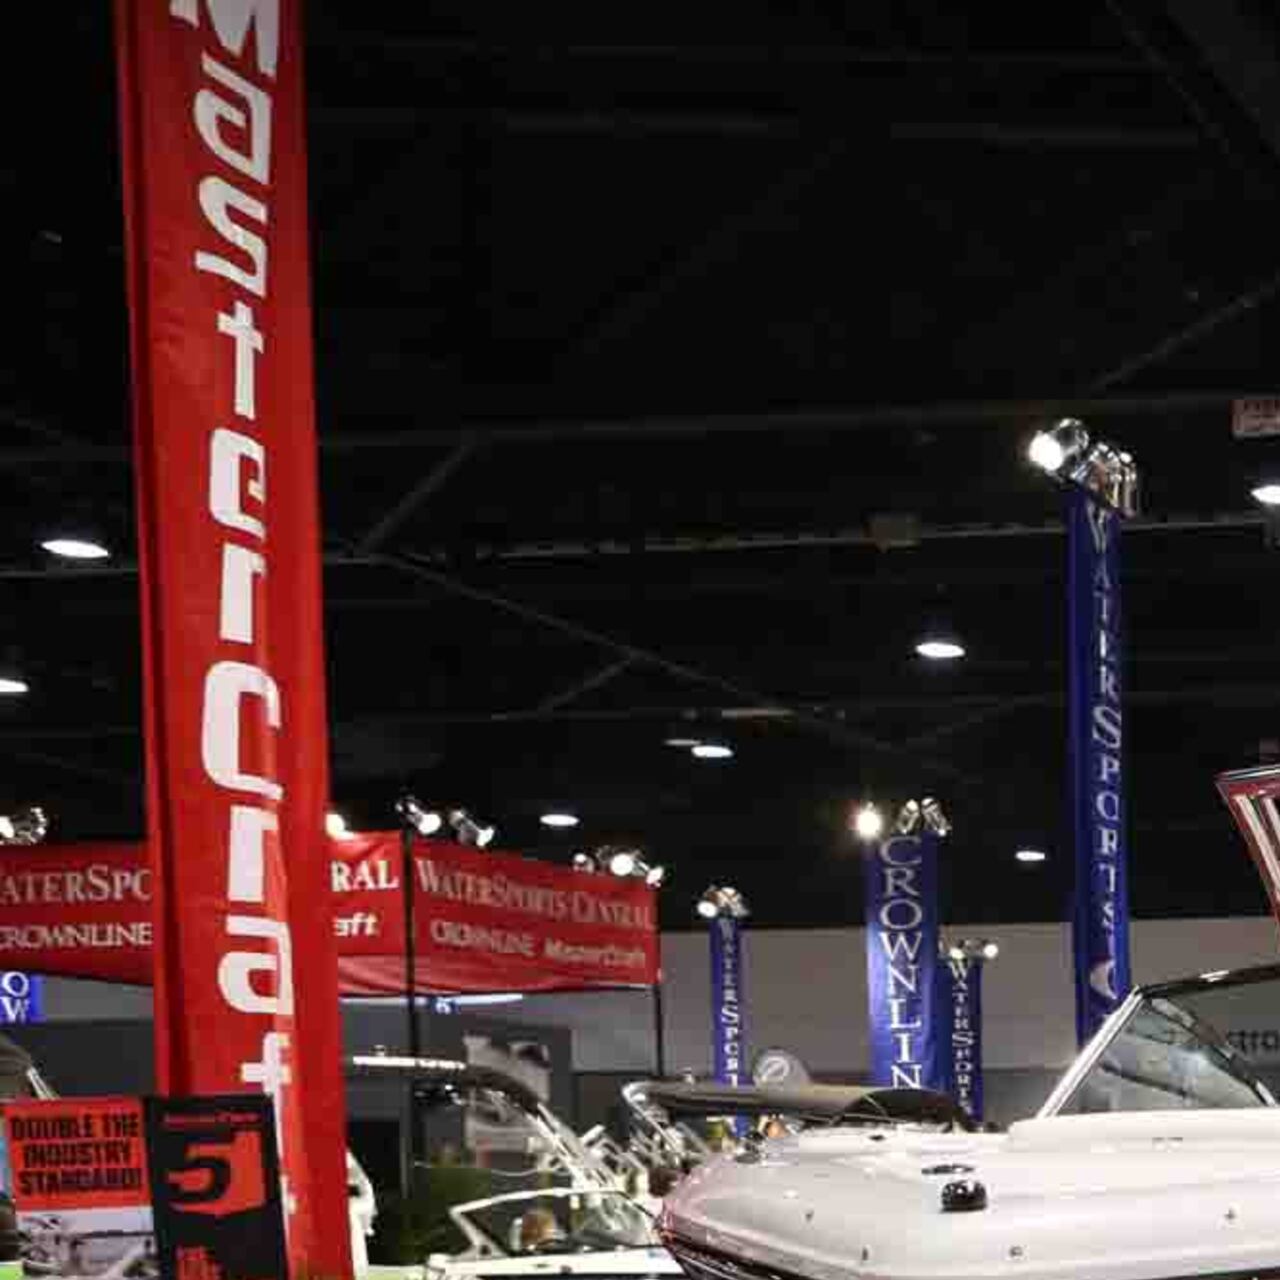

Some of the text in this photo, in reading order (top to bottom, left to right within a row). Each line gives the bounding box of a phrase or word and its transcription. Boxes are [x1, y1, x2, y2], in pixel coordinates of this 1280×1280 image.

[0, 864, 152, 905] ATERSPO
[879, 837, 923, 1089] CROWNLIN
[718, 918, 740, 1088] WATERSPORT
